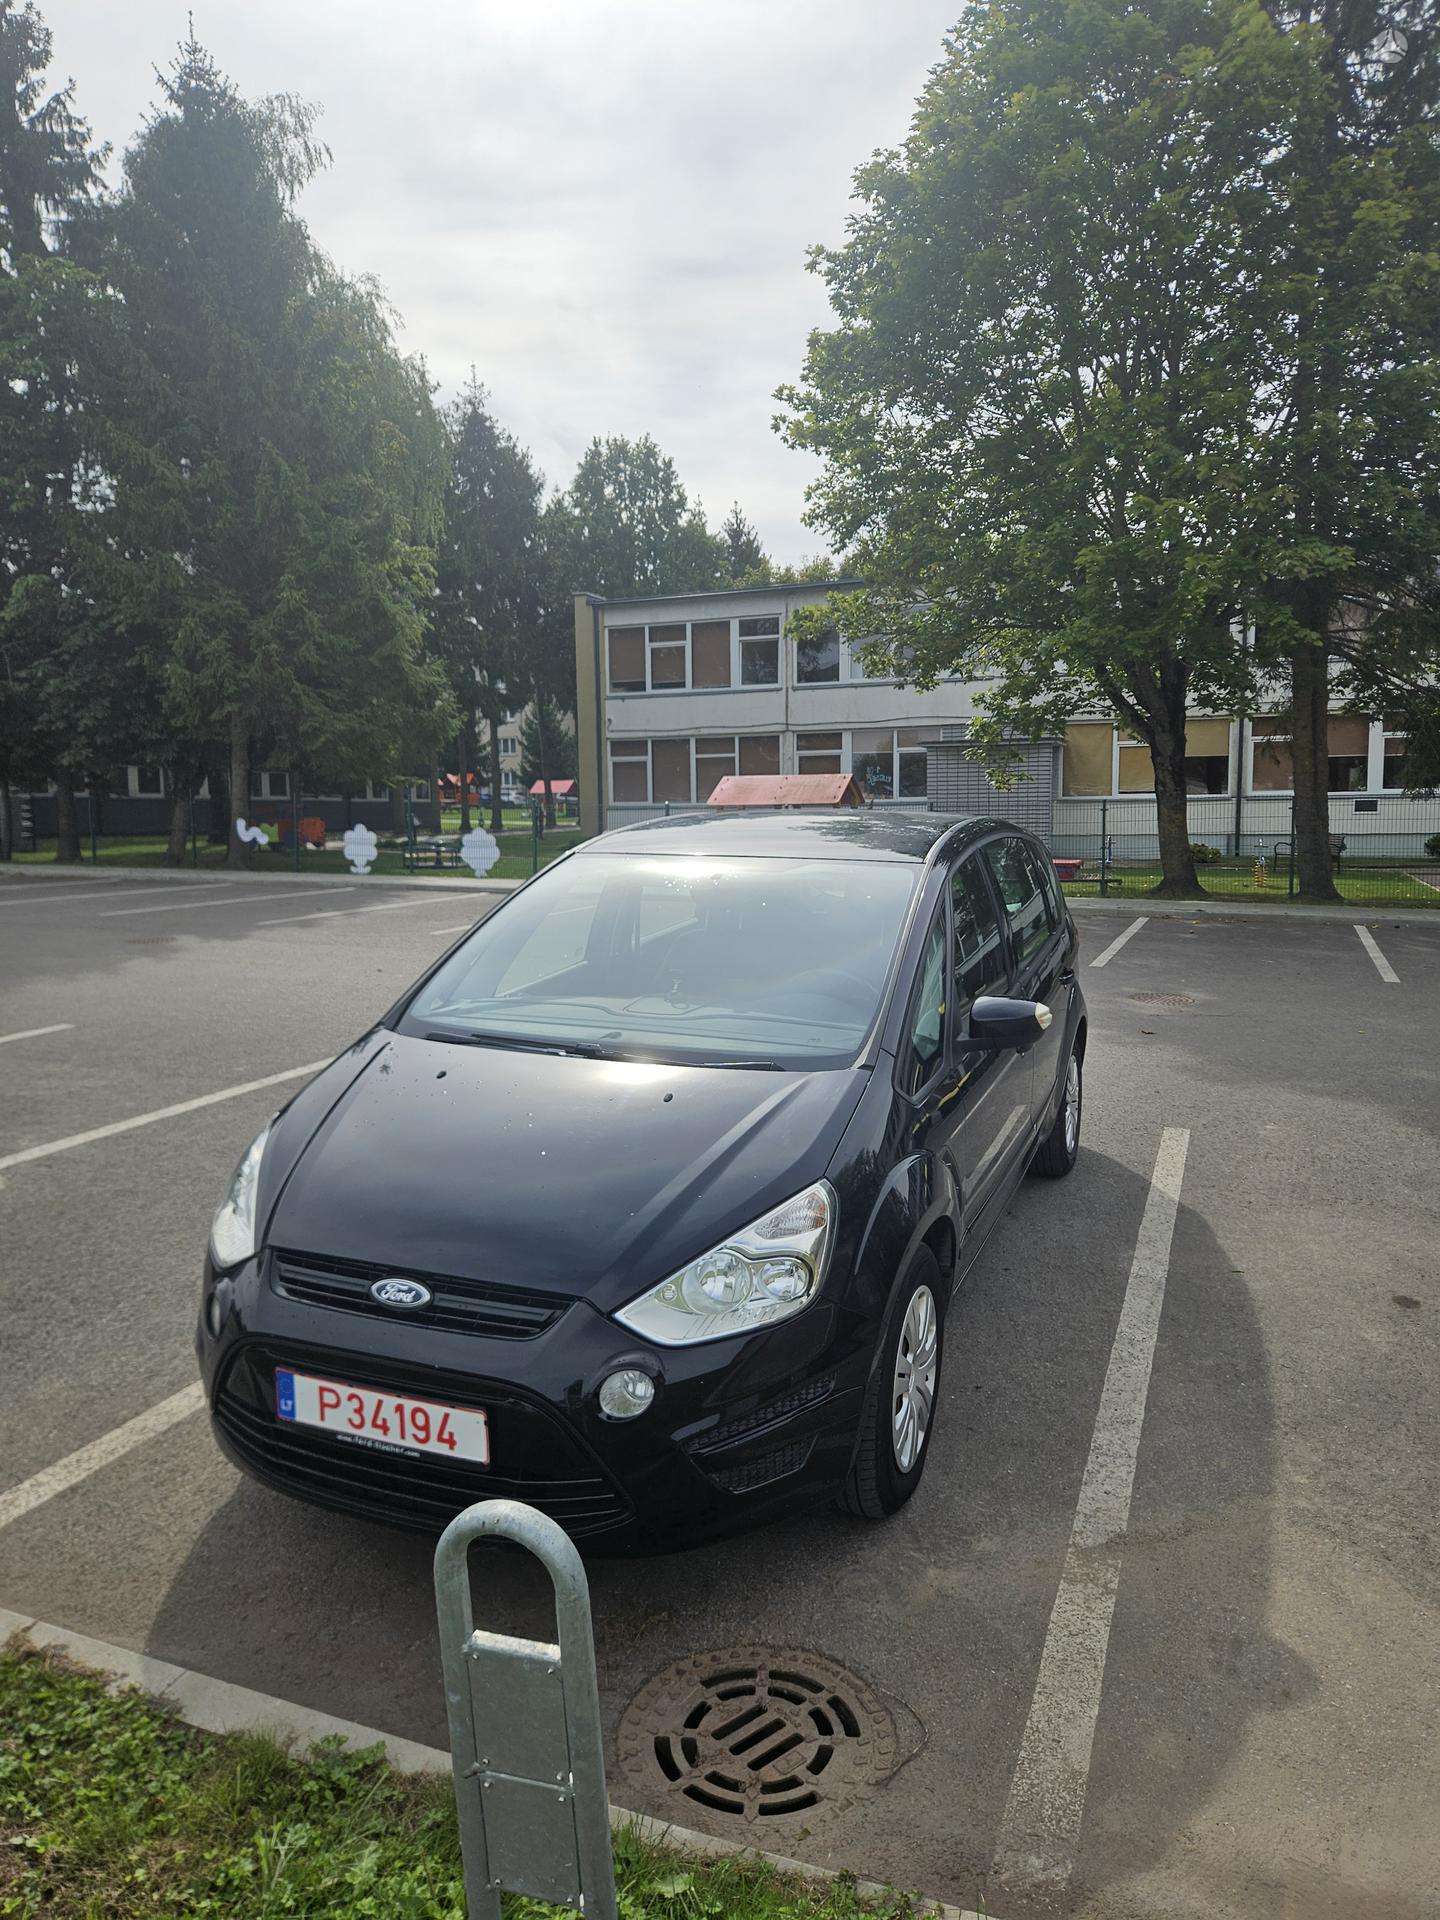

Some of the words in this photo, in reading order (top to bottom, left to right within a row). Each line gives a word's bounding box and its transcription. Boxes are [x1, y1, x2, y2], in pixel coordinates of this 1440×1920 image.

[380, 1283, 416, 1303] Ford
[280, 1398, 293, 1411] LT
[318, 1385, 458, 1451] P34194
